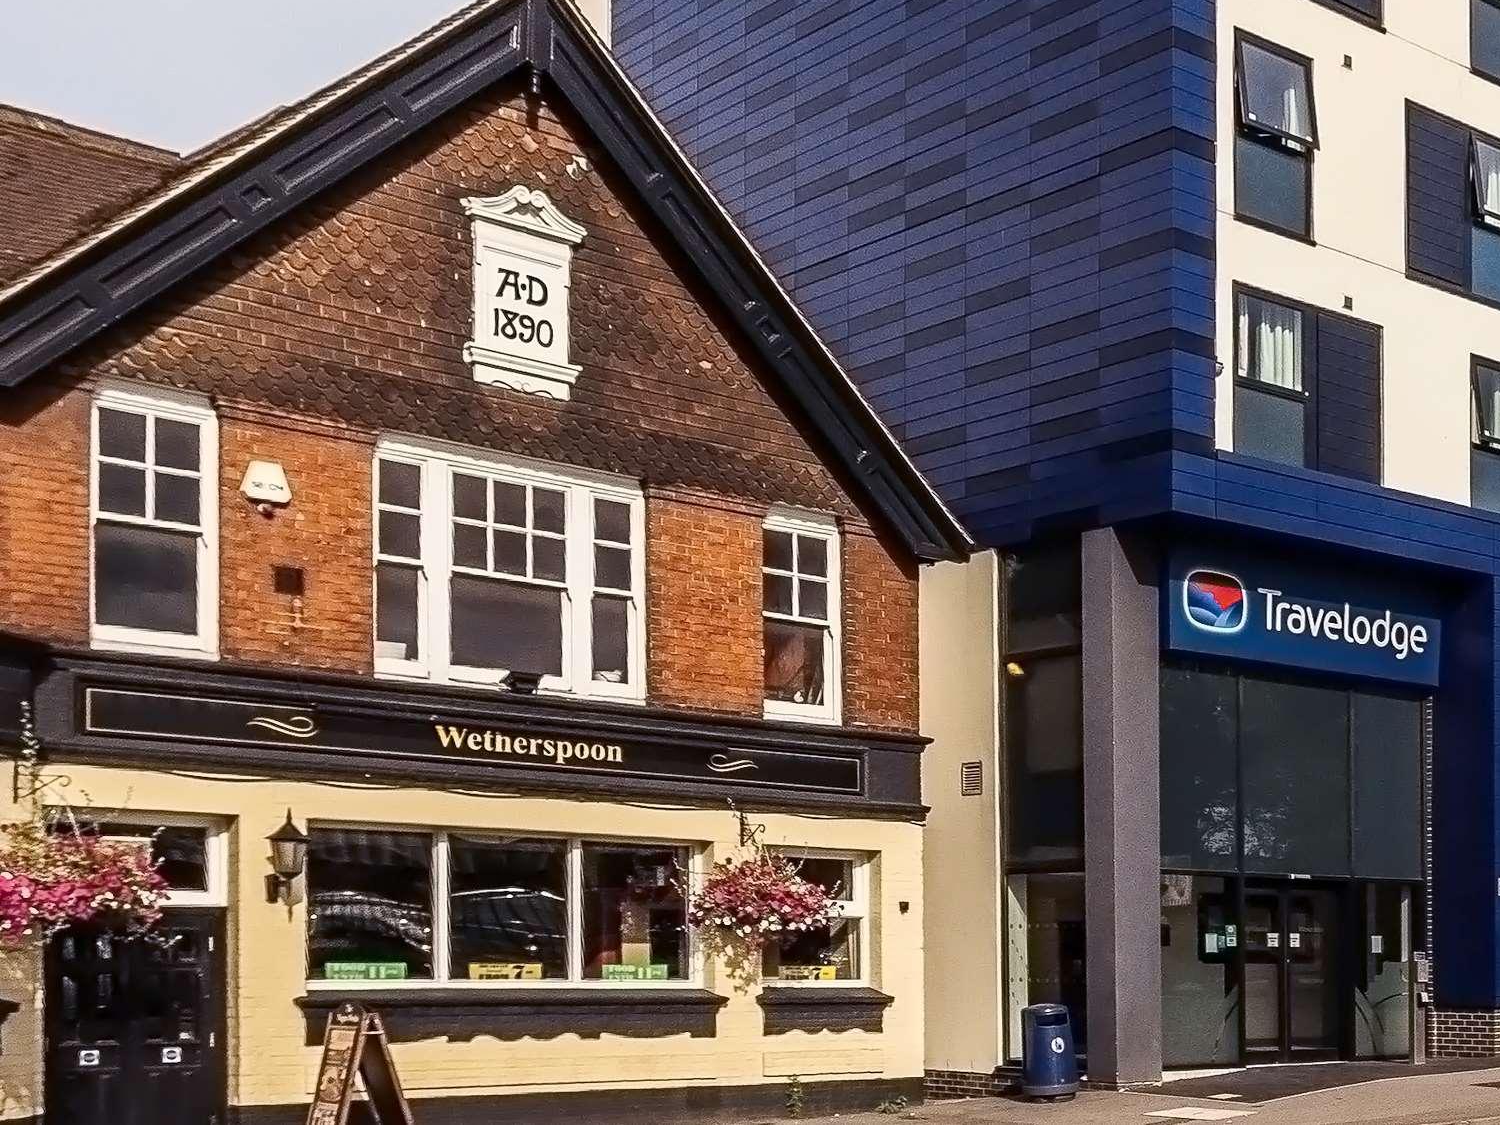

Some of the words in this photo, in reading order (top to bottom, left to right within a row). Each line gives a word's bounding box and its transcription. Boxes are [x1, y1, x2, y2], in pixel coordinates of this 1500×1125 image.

[493, 308, 554, 348] 1890
[1257, 588, 1428, 660] Travelodge
[435, 725, 624, 764] Wetherspoon
